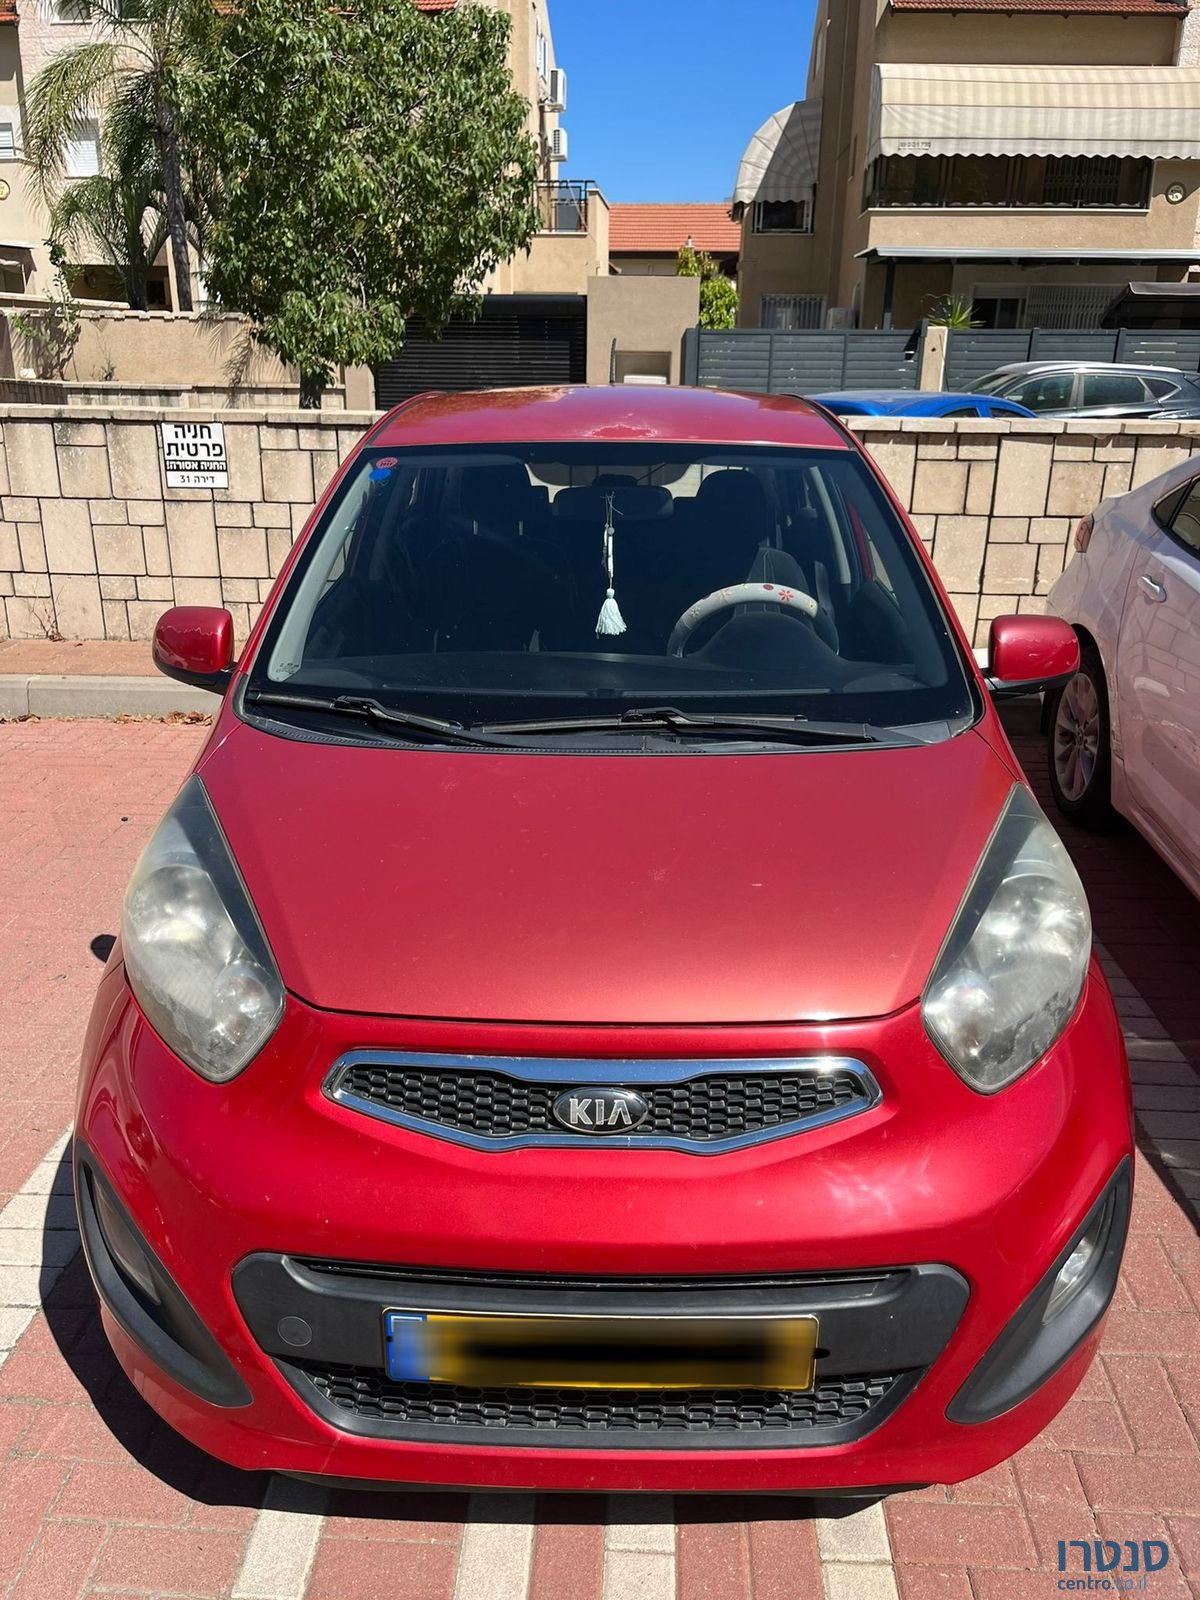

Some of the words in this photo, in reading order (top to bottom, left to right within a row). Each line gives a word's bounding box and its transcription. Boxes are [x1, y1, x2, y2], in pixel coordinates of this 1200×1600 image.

[174, 424, 212, 439] חניה
[166, 442, 223, 457] פרטית
[166, 460, 199, 470] אסורה!
[200, 461, 226, 471] החניה
[180, 474, 190, 484] 31
[194, 475, 215, 484] דירה
[569, 1098, 633, 1126] KIA
